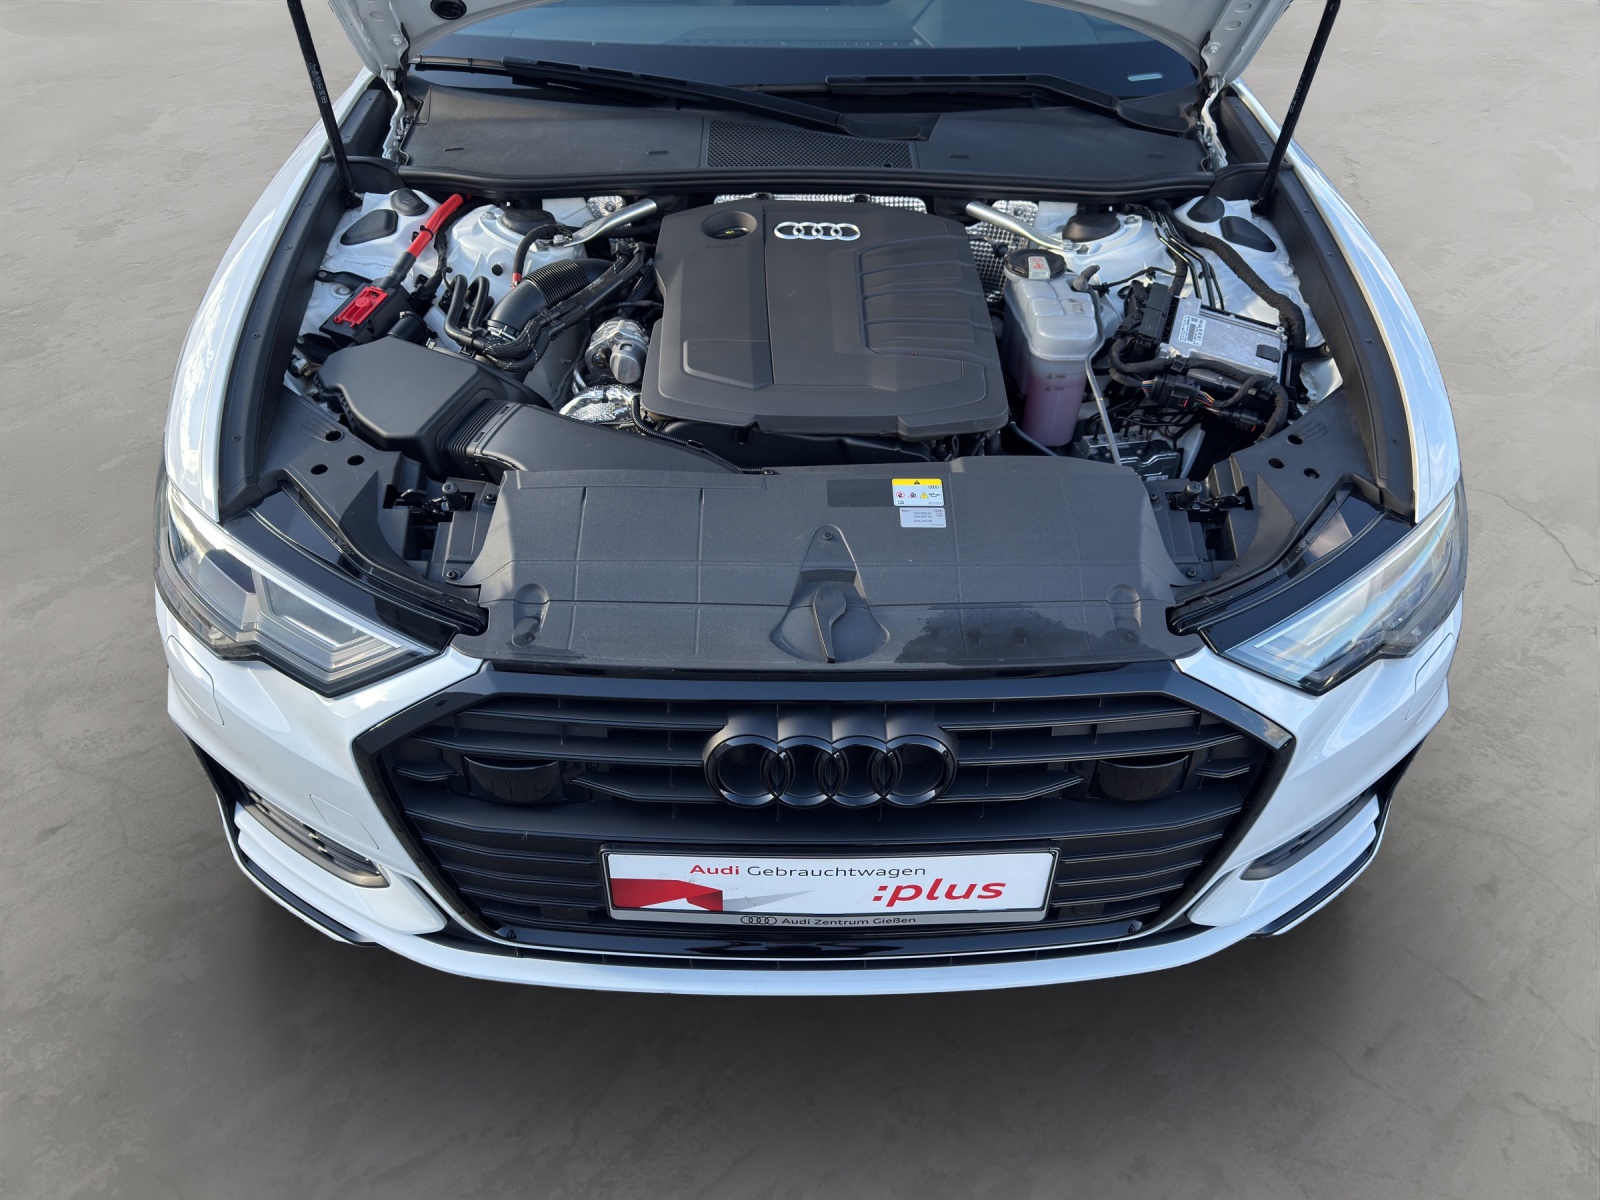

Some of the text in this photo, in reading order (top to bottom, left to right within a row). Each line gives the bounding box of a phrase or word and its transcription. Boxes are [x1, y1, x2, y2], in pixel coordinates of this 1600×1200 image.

[690, 865, 926, 878] Audi Gebrauchtwagen
[872, 878, 1006, 907] :plus
[872, 917, 916, 925] Gießen
